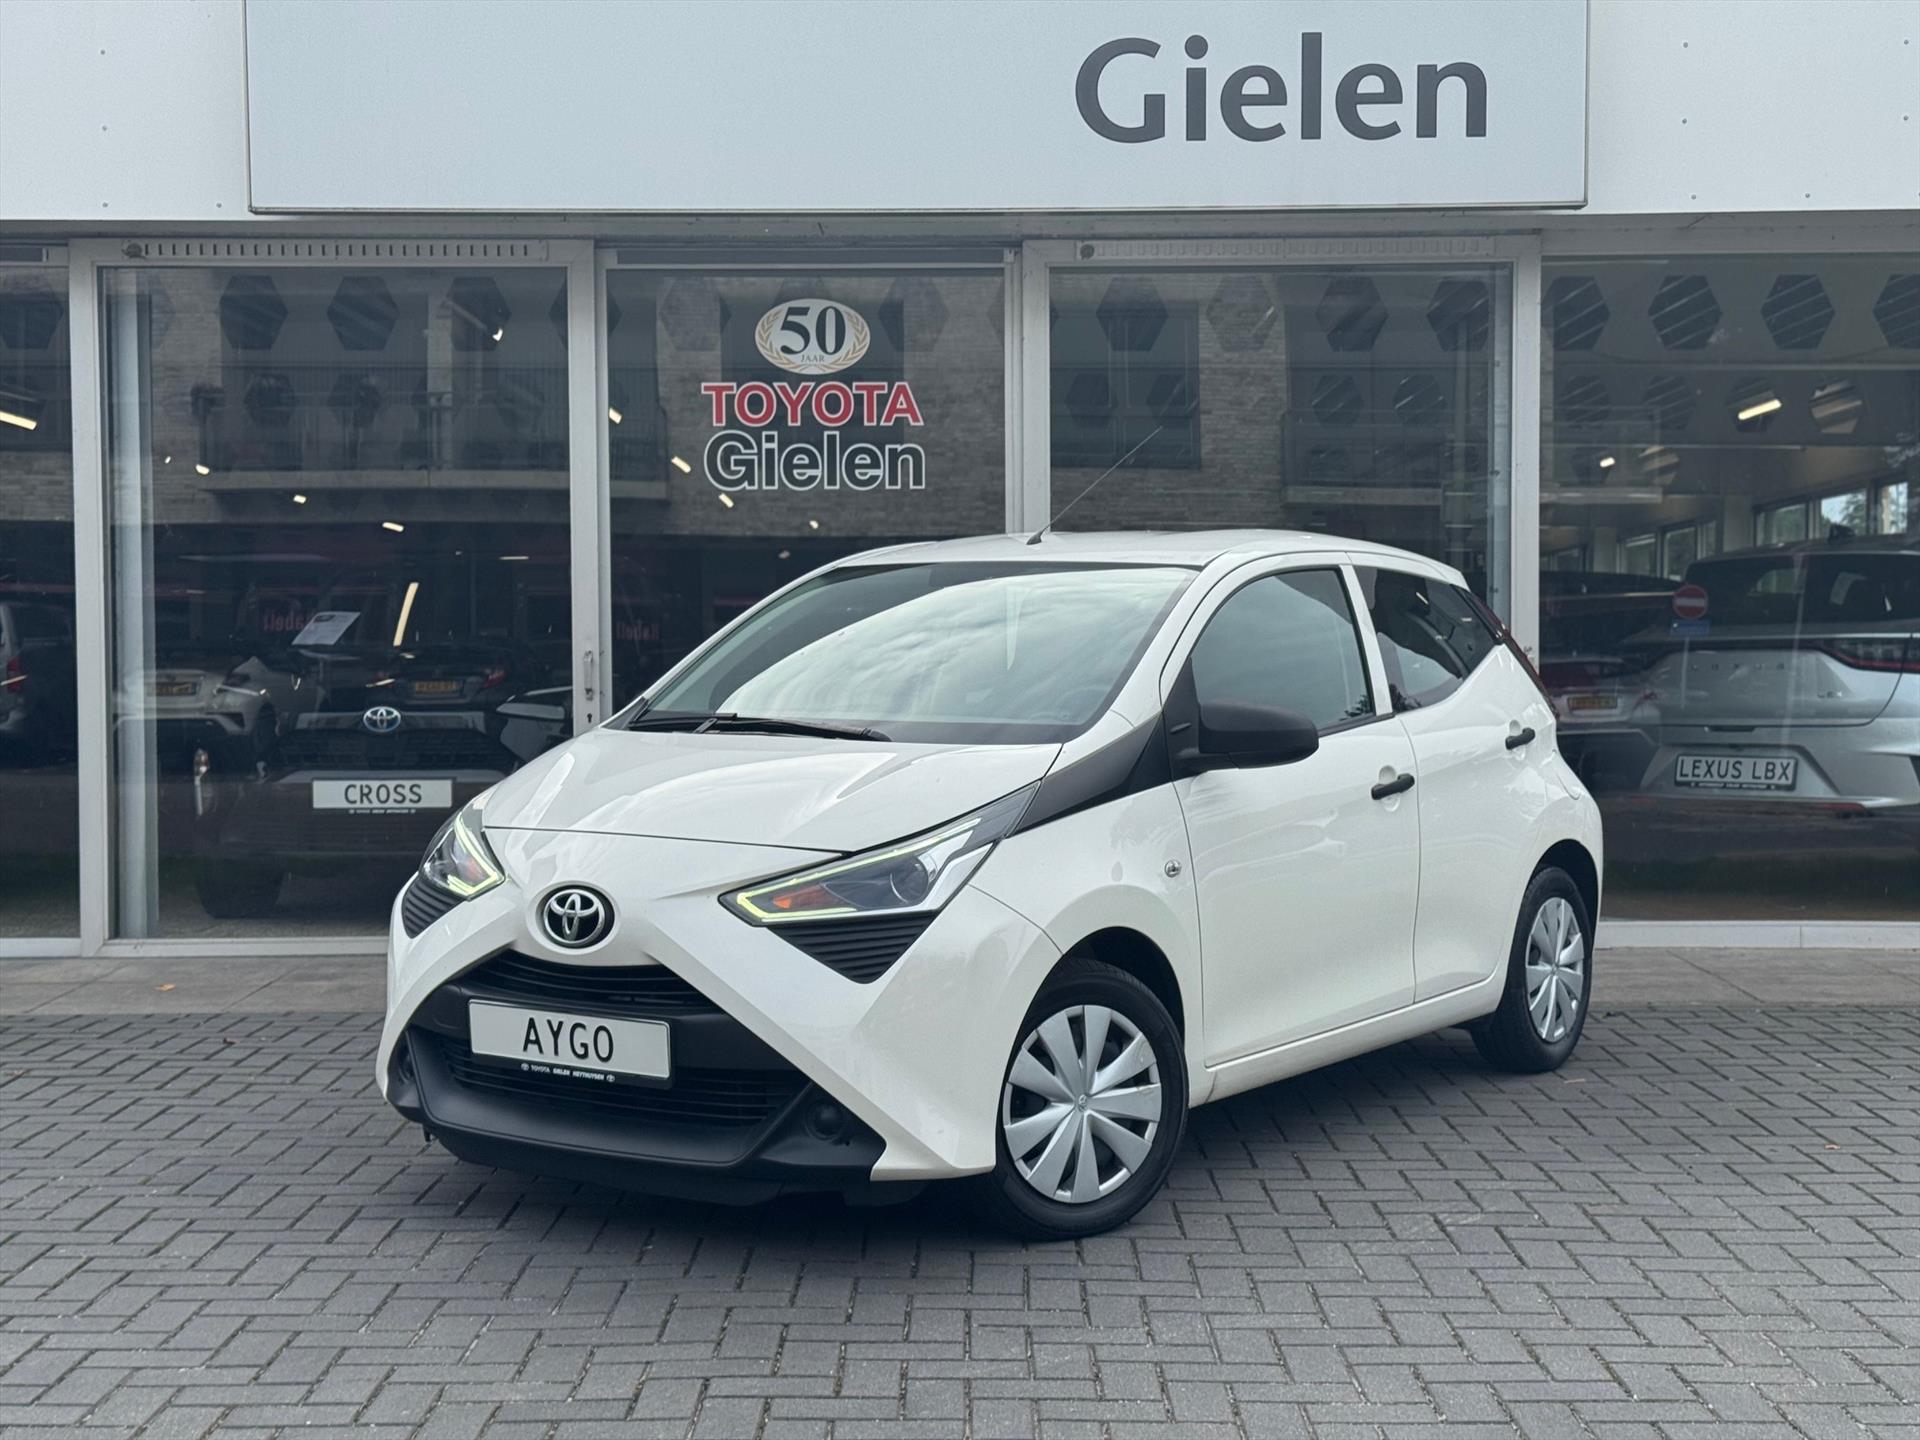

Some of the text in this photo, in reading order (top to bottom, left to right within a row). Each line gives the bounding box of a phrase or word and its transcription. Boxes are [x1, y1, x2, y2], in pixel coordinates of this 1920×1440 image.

[1076, 32, 1488, 144] Gielen
[780, 305, 847, 356] 50
[801, 355, 825, 363] JAAR
[701, 381, 925, 427] TOYOTA
[703, 430, 926, 491] Gielen
[1679, 758, 1792, 782] LEXUS LBX
[344, 783, 423, 805] CROSS
[522, 1016, 614, 1063] AYGO
[530, 1065, 551, 1073] TOYOTA
